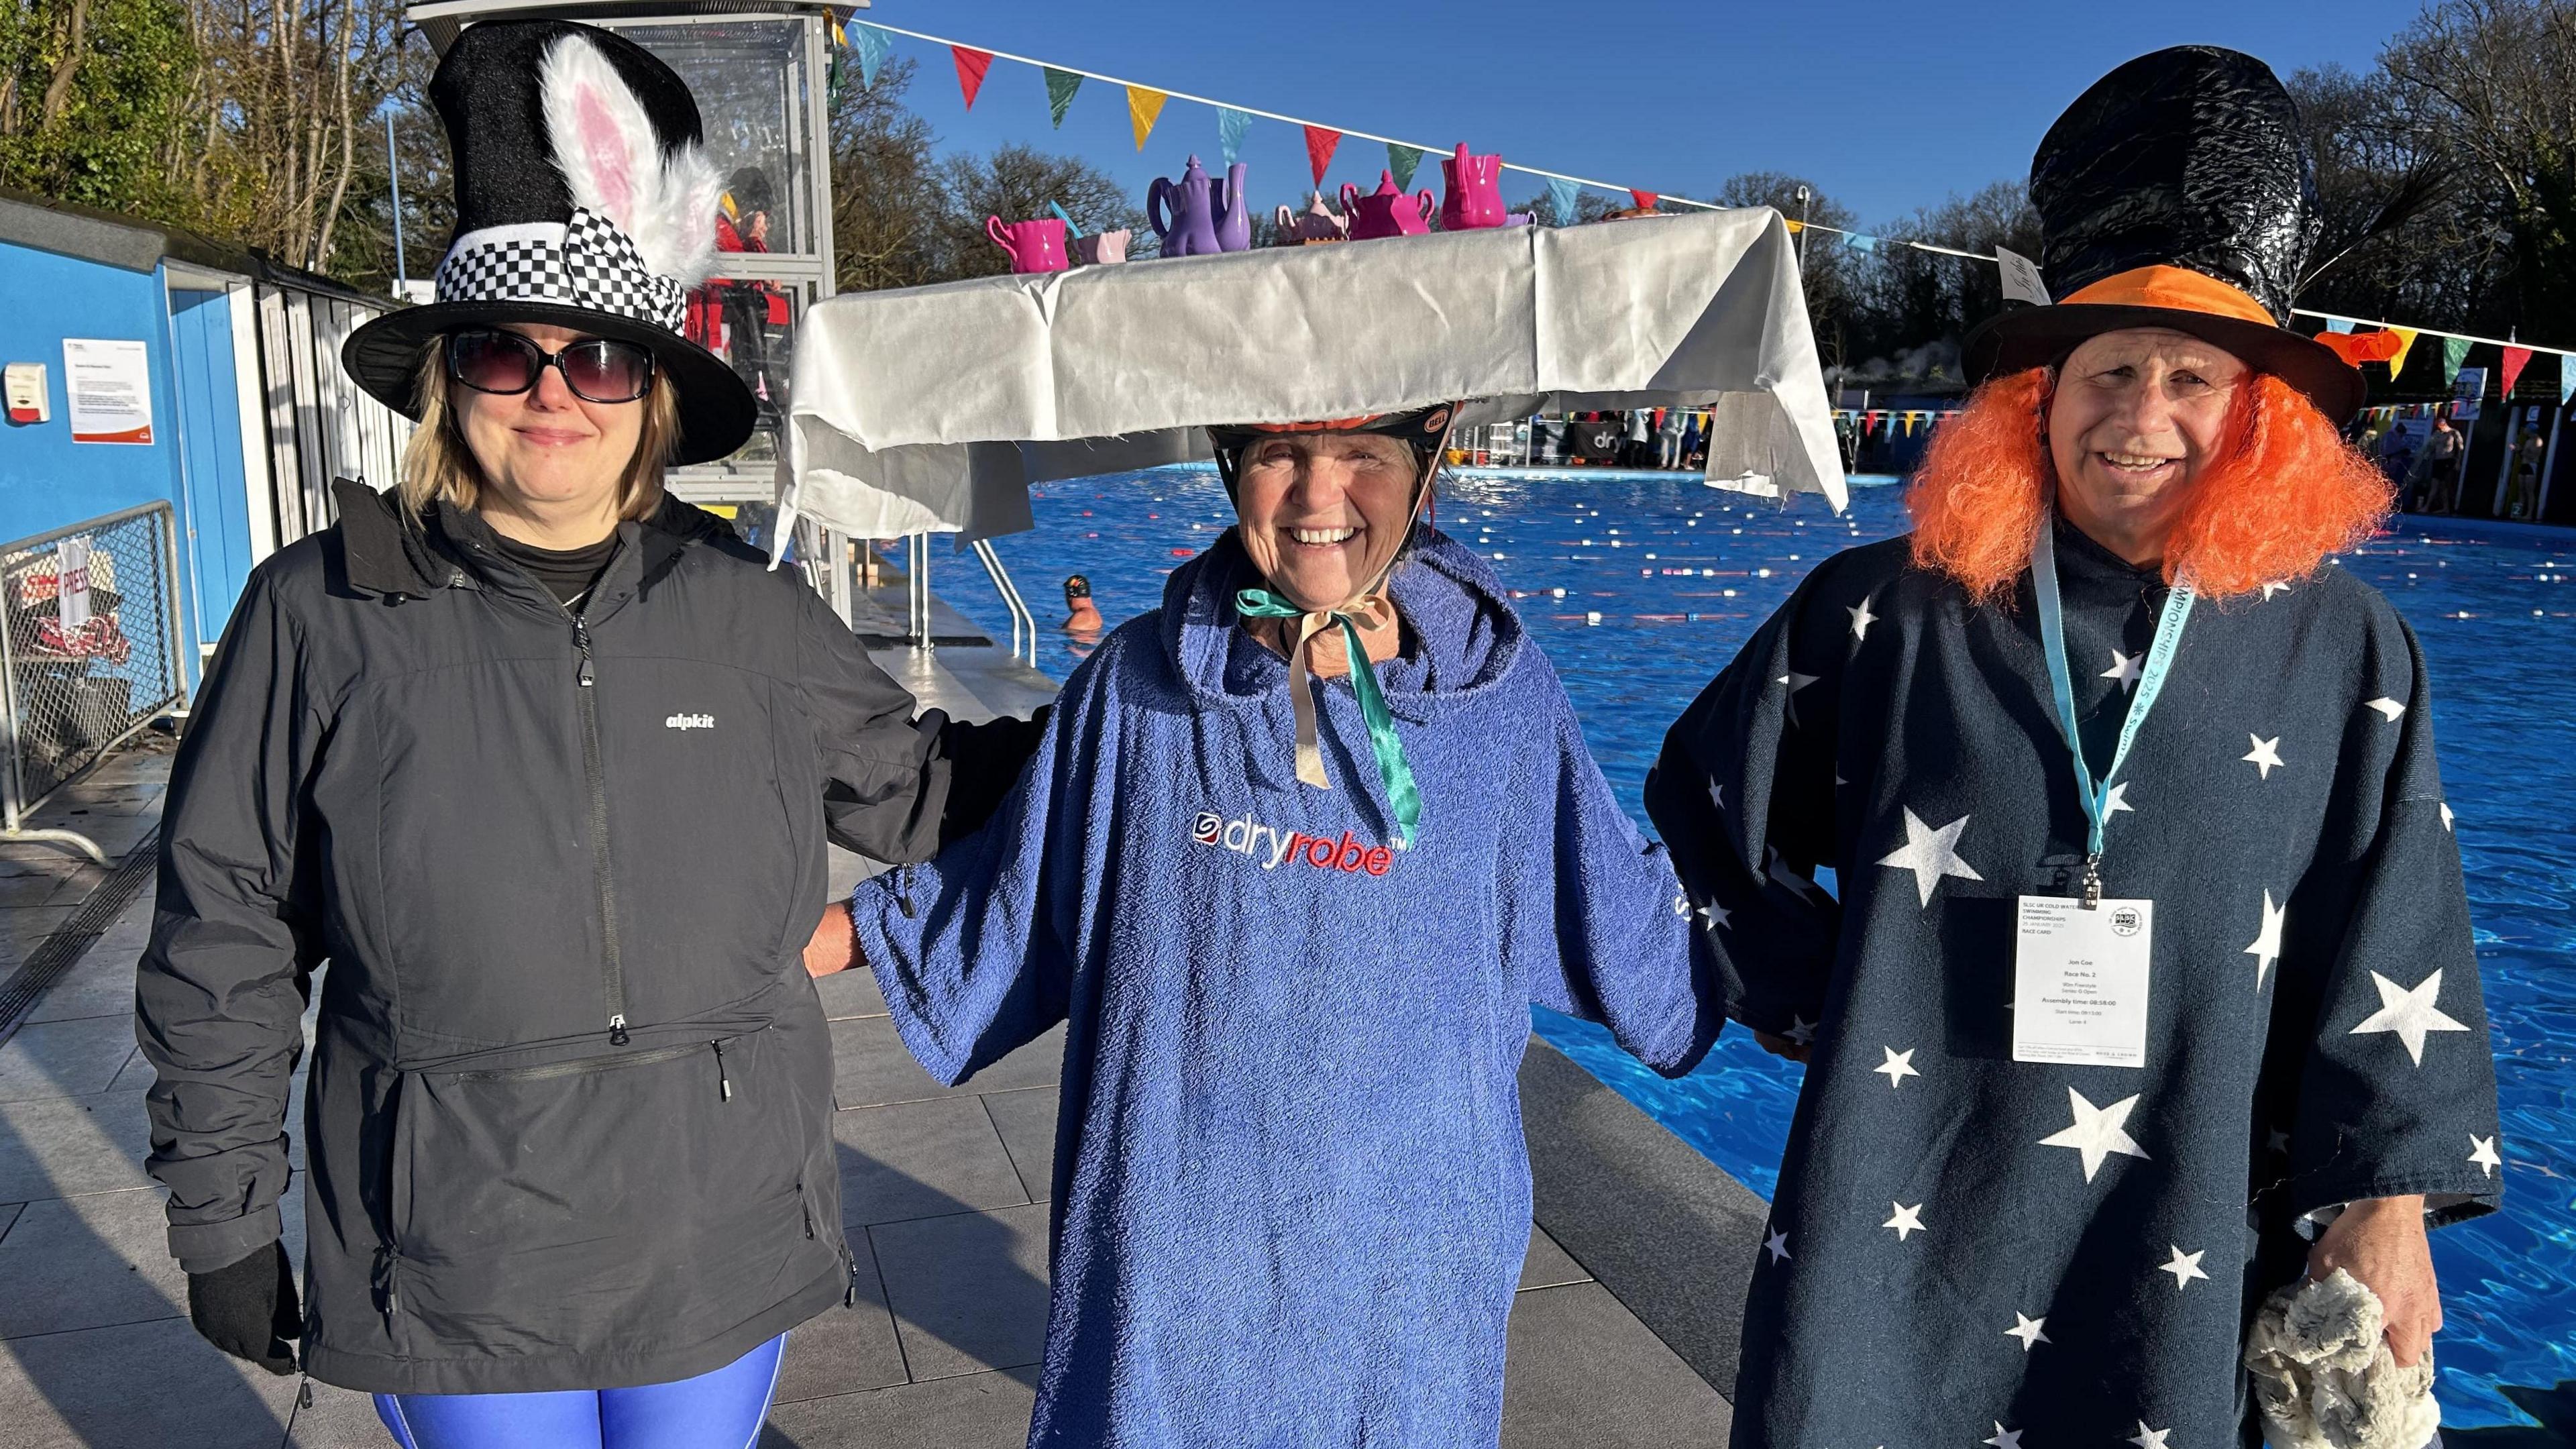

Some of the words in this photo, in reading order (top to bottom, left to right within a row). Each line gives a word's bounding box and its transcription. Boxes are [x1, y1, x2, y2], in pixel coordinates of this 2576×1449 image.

[1429, 414, 1446, 428] BELL
[64, 566, 89, 598] PRESS
[2151, 574, 2192, 667] AMPIONSHIPS
[2141, 671, 2159, 698] 2025
[665, 713, 714, 731] alpkit
[1224, 812, 1393, 876] dryrobe
